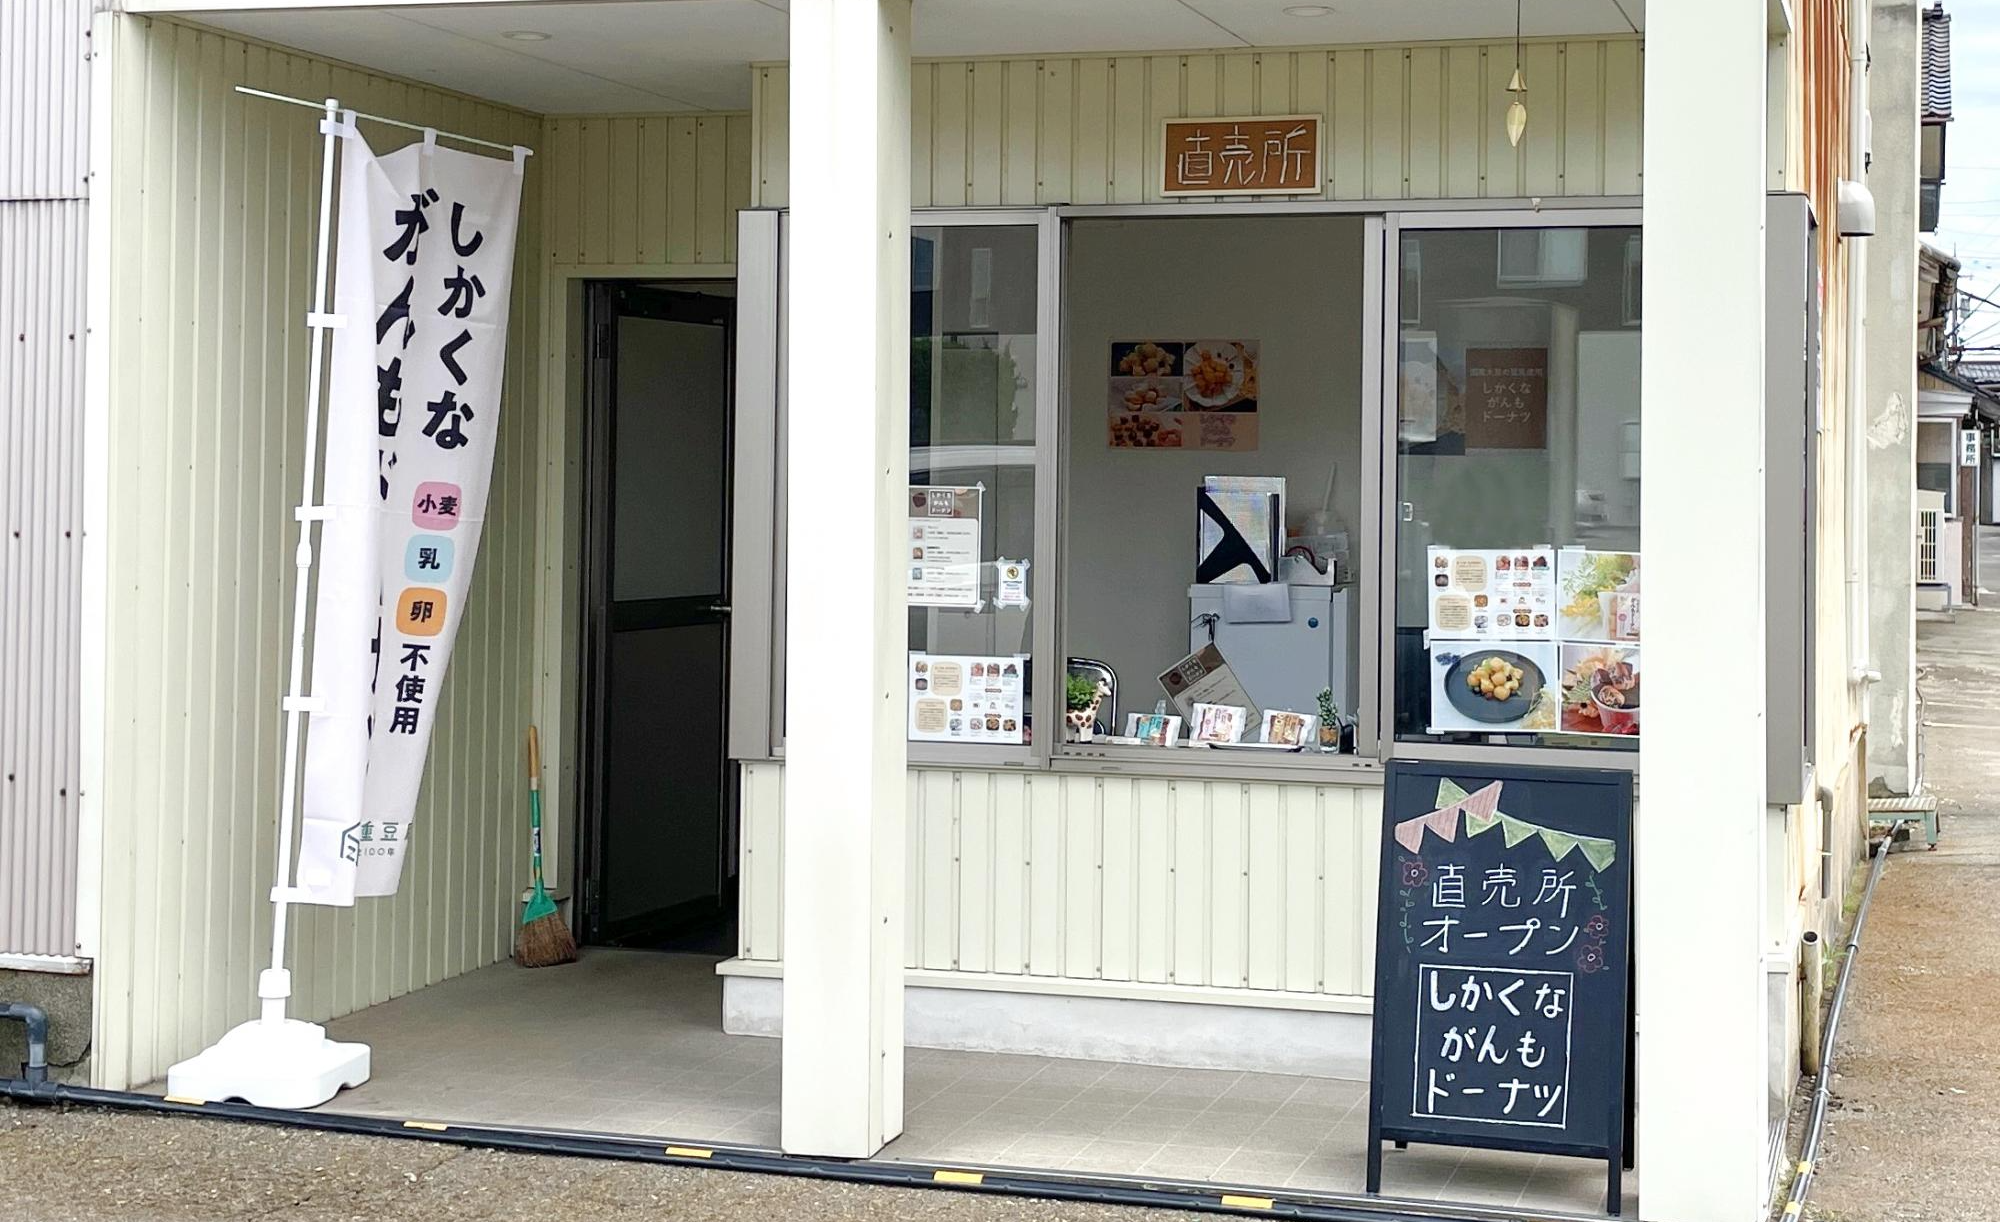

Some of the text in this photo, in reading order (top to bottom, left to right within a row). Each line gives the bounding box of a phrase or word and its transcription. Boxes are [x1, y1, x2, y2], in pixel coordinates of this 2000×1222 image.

[1178, 124, 1311, 185] 直売所
[422, 201, 486, 450] しかくな
[1482, 381, 1532, 394] しかくな
[1487, 396, 1525, 409] がんも
[1482, 410, 1532, 423] ドーナツ
[1965, 432, 1976, 464] 事務所
[389, 493, 458, 735] 小麦 乳 卵 不使用
[1432, 863, 1577, 918] 直売所
[1420, 915, 1580, 956] オープン
[1430, 970, 1566, 1019] しかくな
[1440, 1024, 1547, 1068] がんも
[1427, 1068, 1563, 1117] ドーナツ
